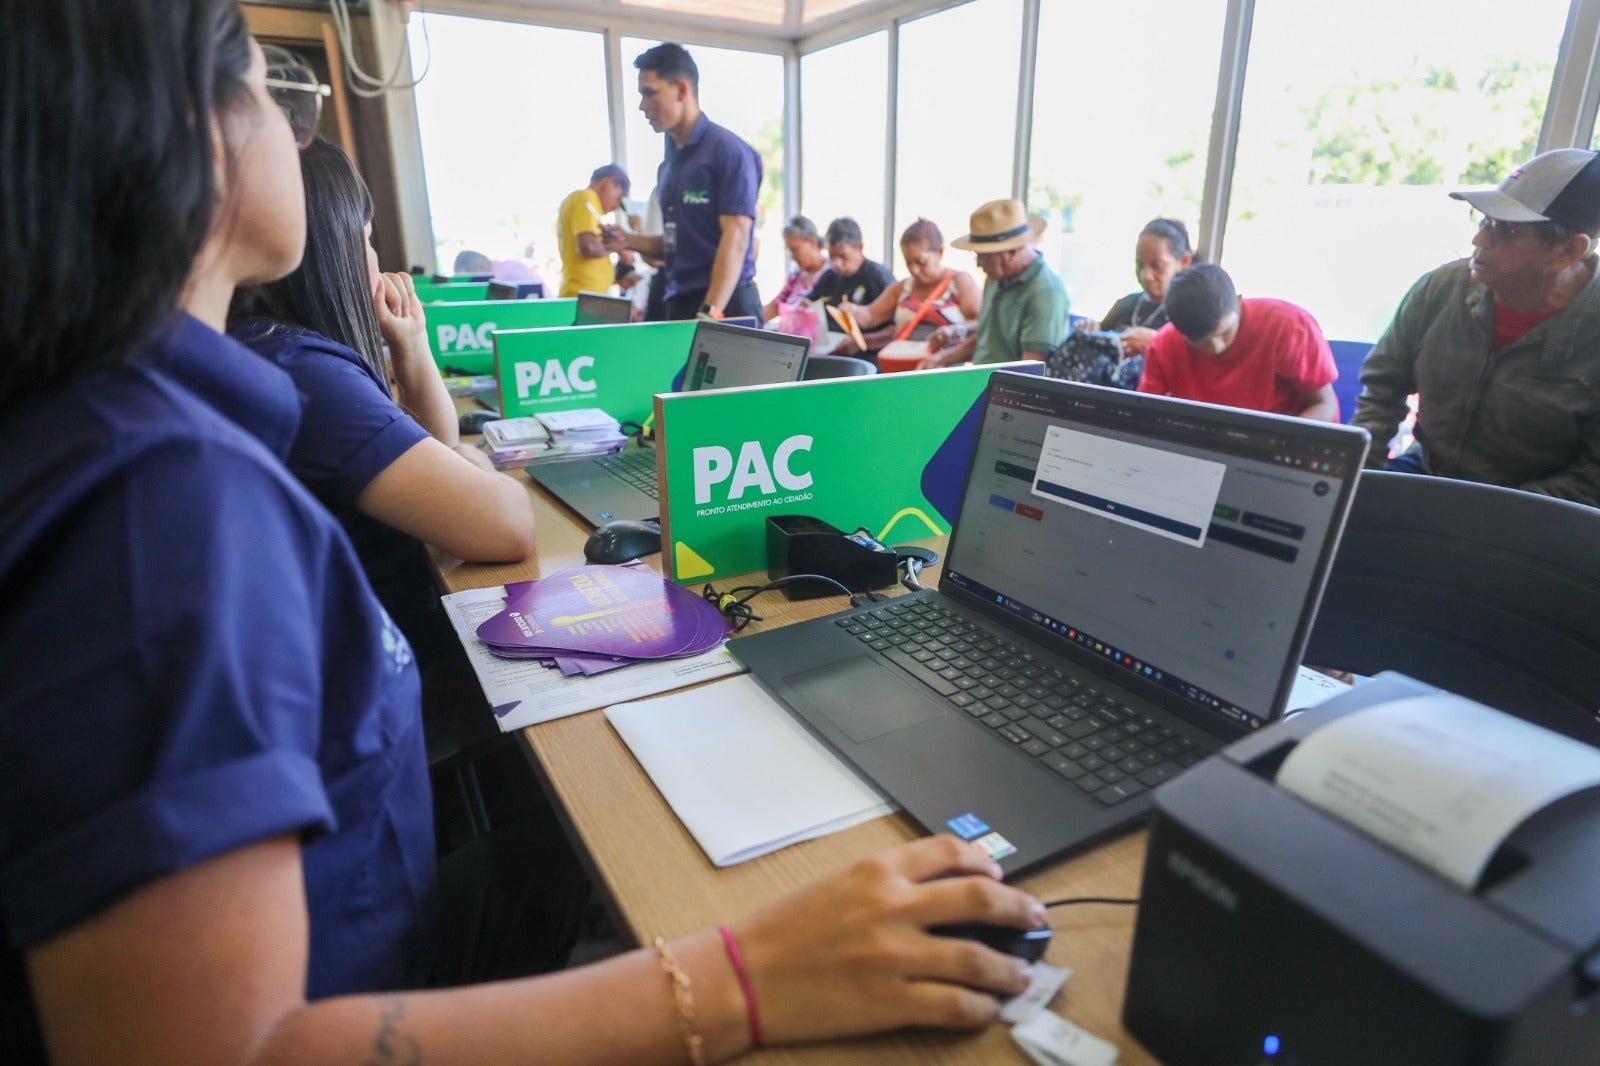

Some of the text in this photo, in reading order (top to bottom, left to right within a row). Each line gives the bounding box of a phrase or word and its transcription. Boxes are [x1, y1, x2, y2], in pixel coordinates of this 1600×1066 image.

[438, 323, 497, 352] PAC
[514, 356, 597, 399] PAC
[693, 435, 813, 504] PAC
[696, 492, 813, 517] PRONTO ATENDIMENTO AO CIDADÃO
